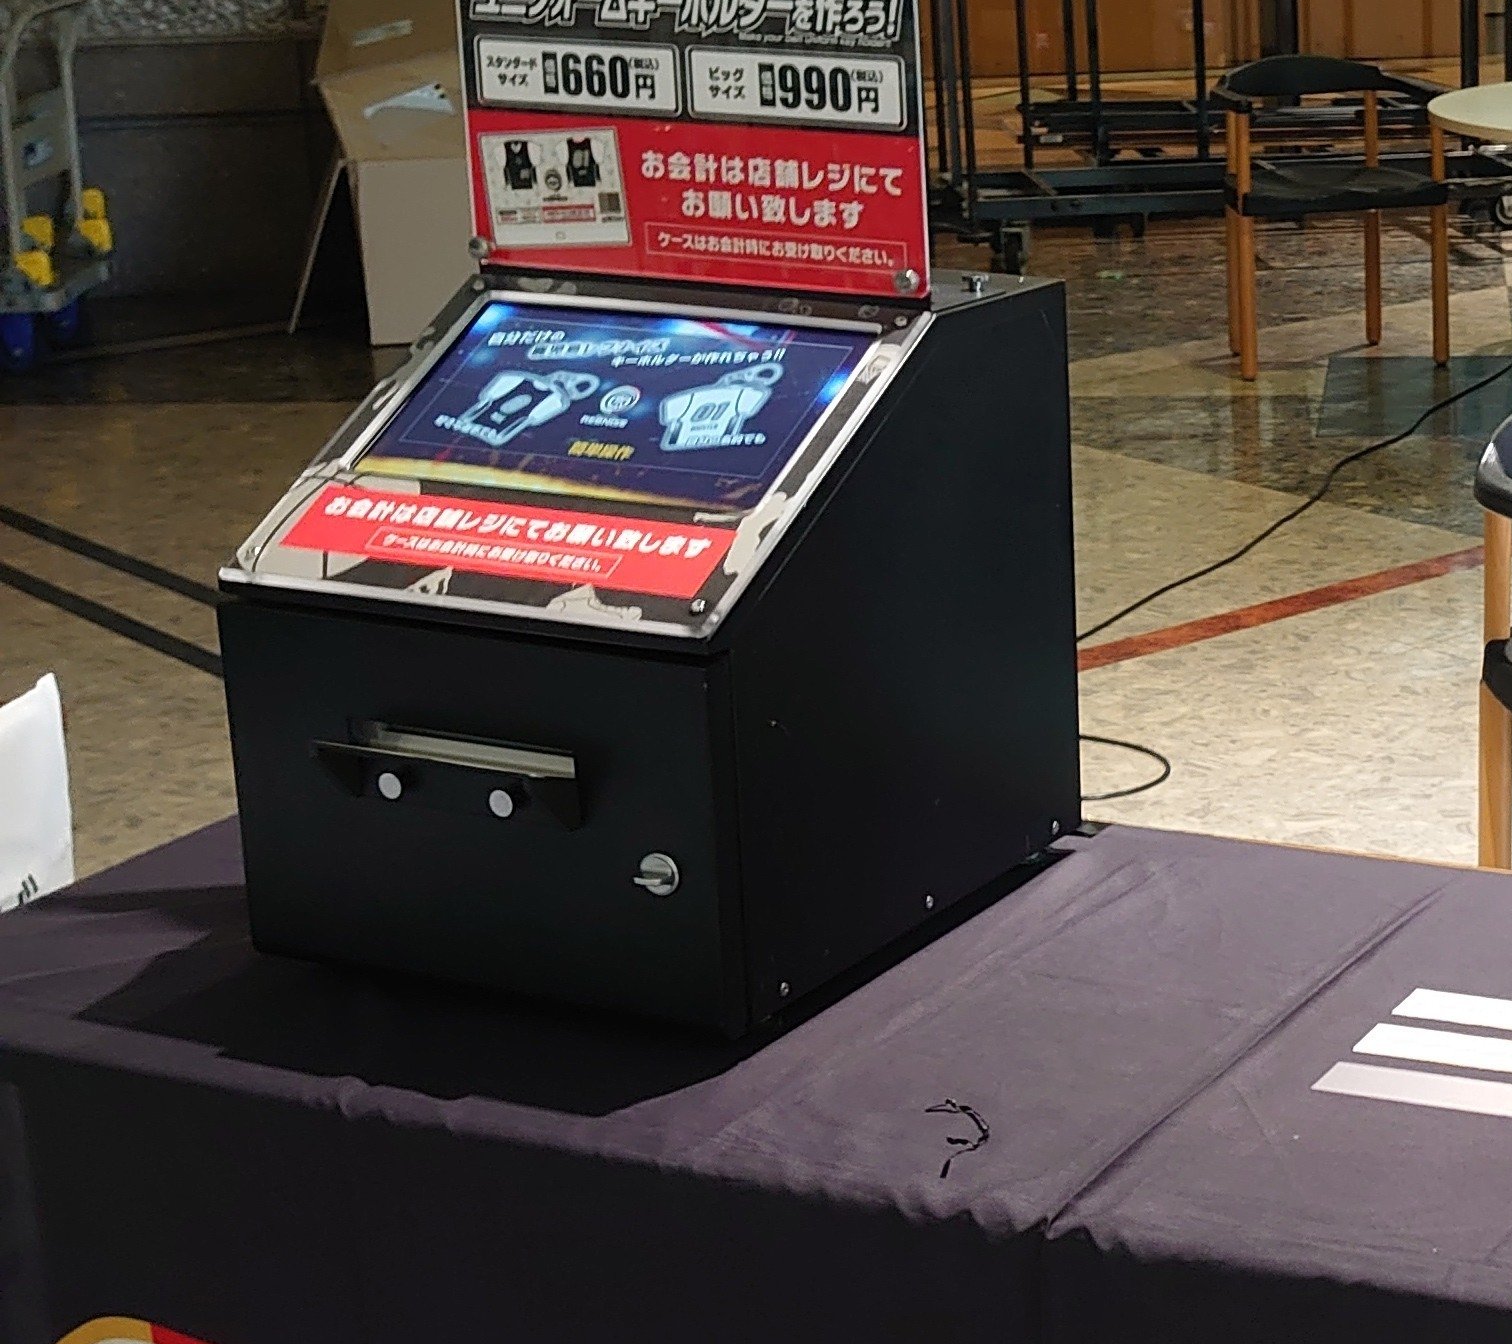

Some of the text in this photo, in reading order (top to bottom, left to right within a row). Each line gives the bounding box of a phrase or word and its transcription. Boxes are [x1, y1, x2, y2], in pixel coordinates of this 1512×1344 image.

[497, 73, 529, 88] サイズ
[708, 85, 746, 101] サイズ
[641, 149, 903, 197] お会計は店舗レジにて
[681, 188, 865, 230] お願い致します
